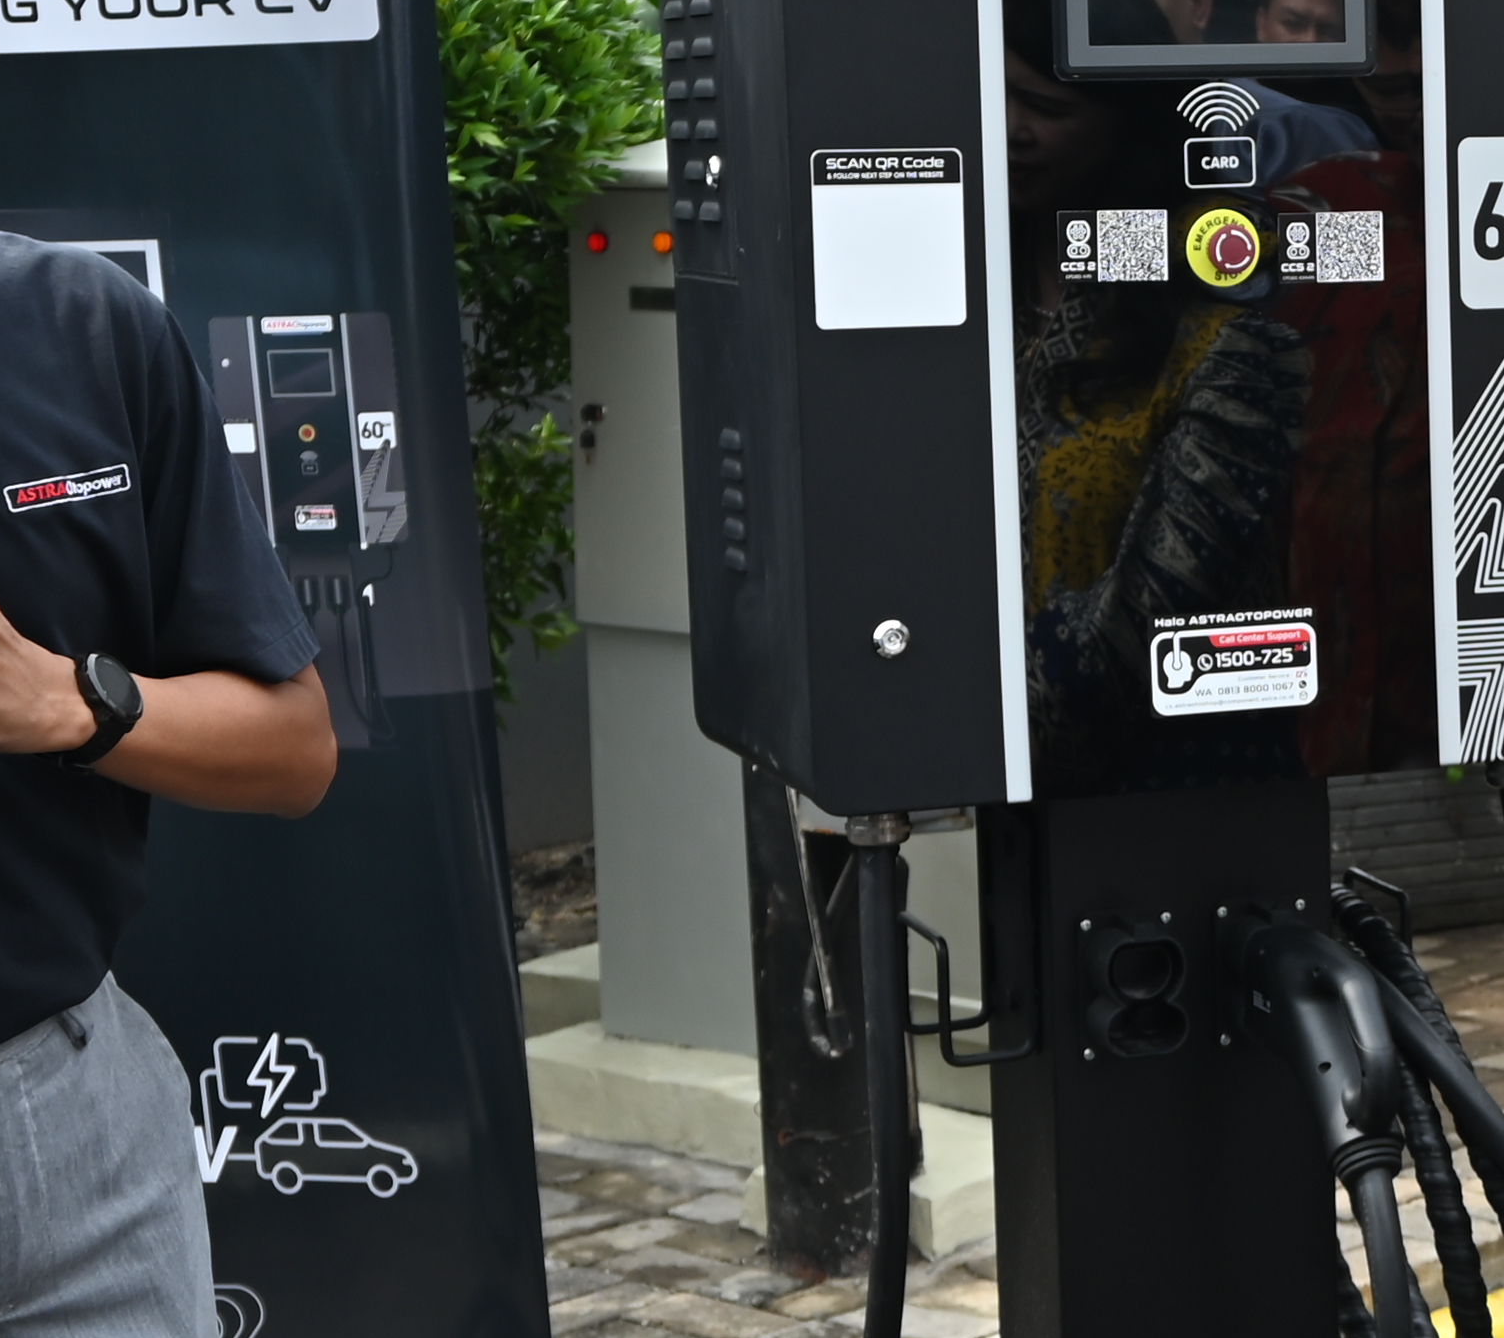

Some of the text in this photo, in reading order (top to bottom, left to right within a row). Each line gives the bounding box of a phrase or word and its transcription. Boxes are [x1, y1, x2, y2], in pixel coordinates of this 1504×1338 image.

[825, 156, 945, 171] SCAN QR Code
[1201, 155, 1240, 170] CARD
[832, 172, 860, 180] FOLLOW
[878, 171, 892, 179] STEP
[893, 171, 905, 179] ON
[918, 170, 944, 178] WEBSITE
[1193, 216, 1246, 251] EMERGEN
[1060, 261, 1096, 272] CCS 2
[1281, 262, 1315, 272] CCS 2
[1214, 269, 1242, 281] STO
[361, 421, 384, 438] 60
[1154, 607, 1313, 628] Halo ASTRAOTOPOWER
[1219, 630, 1302, 644] Call Center Support
[1215, 647, 1294, 668] 1500-725
[1195, 688, 1213, 697] WA
[1243, 684, 1270, 693] 8000
[195, 1126, 238, 1183] V
